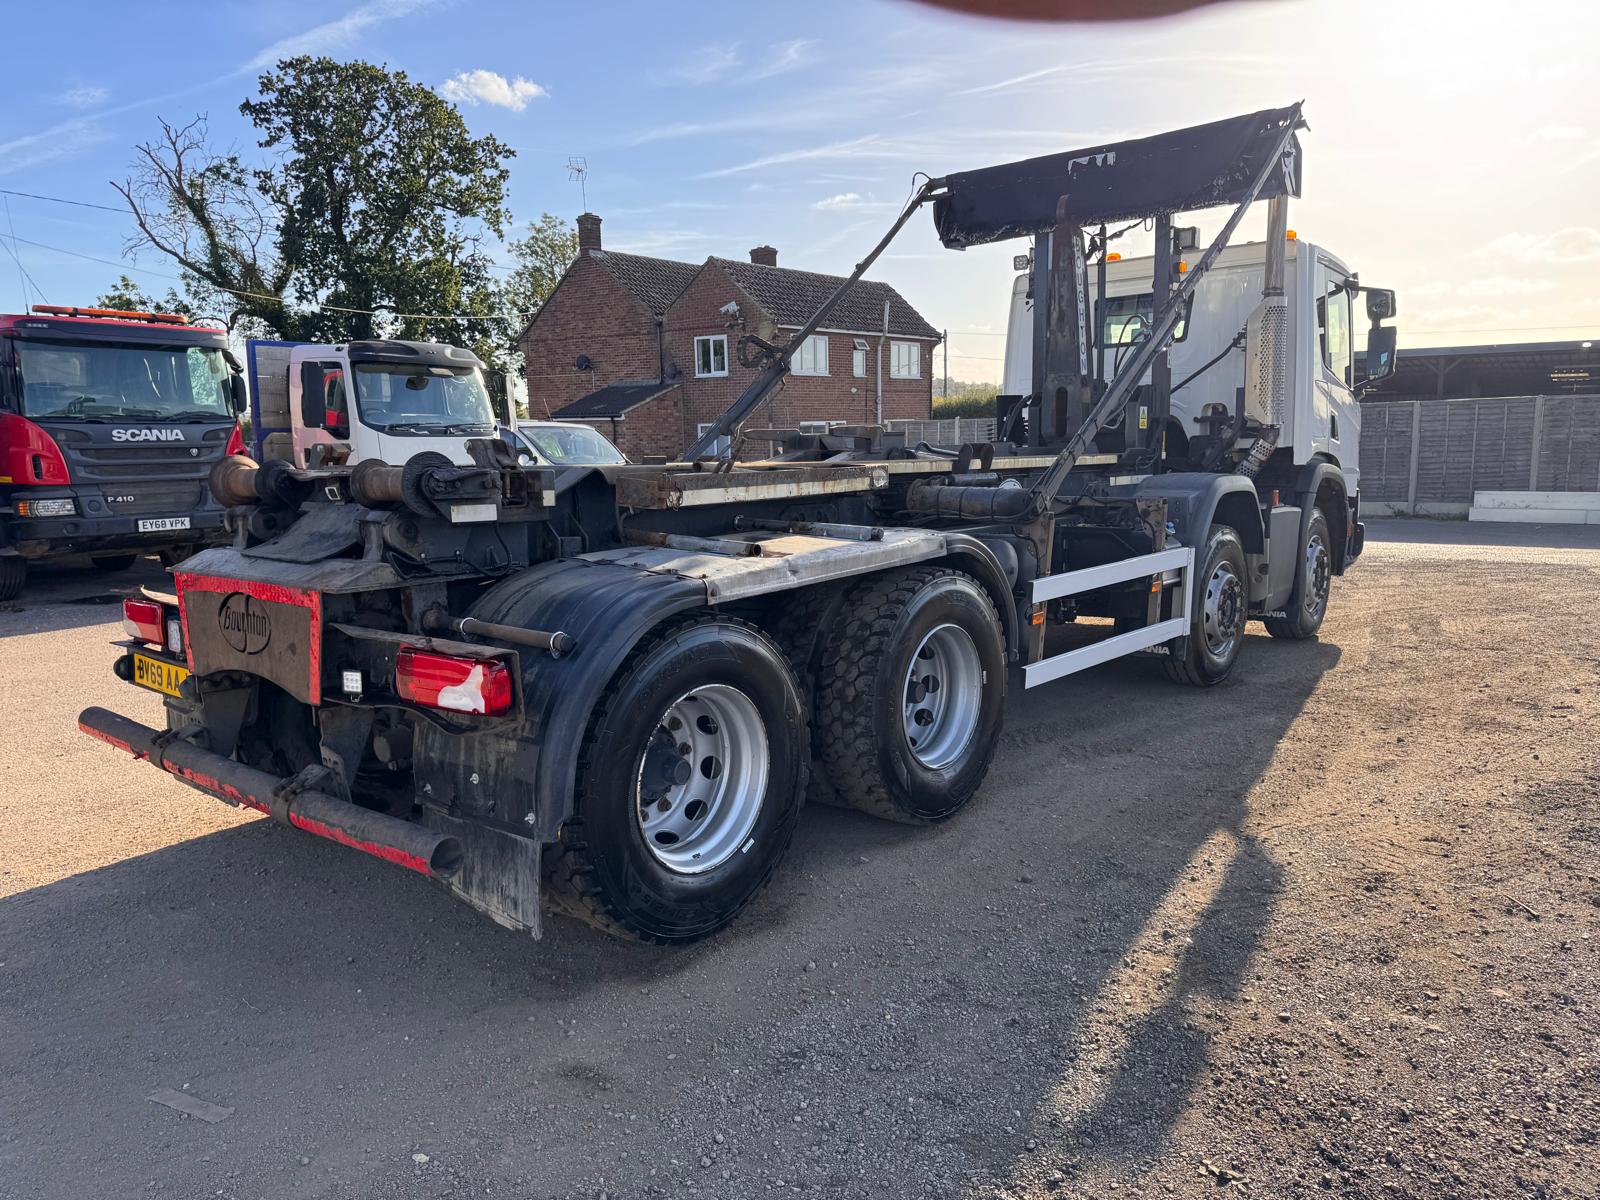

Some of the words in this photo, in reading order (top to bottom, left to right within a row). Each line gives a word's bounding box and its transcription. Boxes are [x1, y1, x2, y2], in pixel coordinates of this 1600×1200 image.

[1075, 237, 1087, 372] BOUGHTON
[111, 429, 185, 441] SCANIA
[116, 495, 135, 503] 410
[142, 520, 167, 530] EY68
[169, 518, 186, 527] VPK
[1248, 609, 1288, 619] SCANIA
[222, 603, 268, 641] Boughton
[138, 658, 163, 688] BV69
[166, 667, 190, 697] AA
